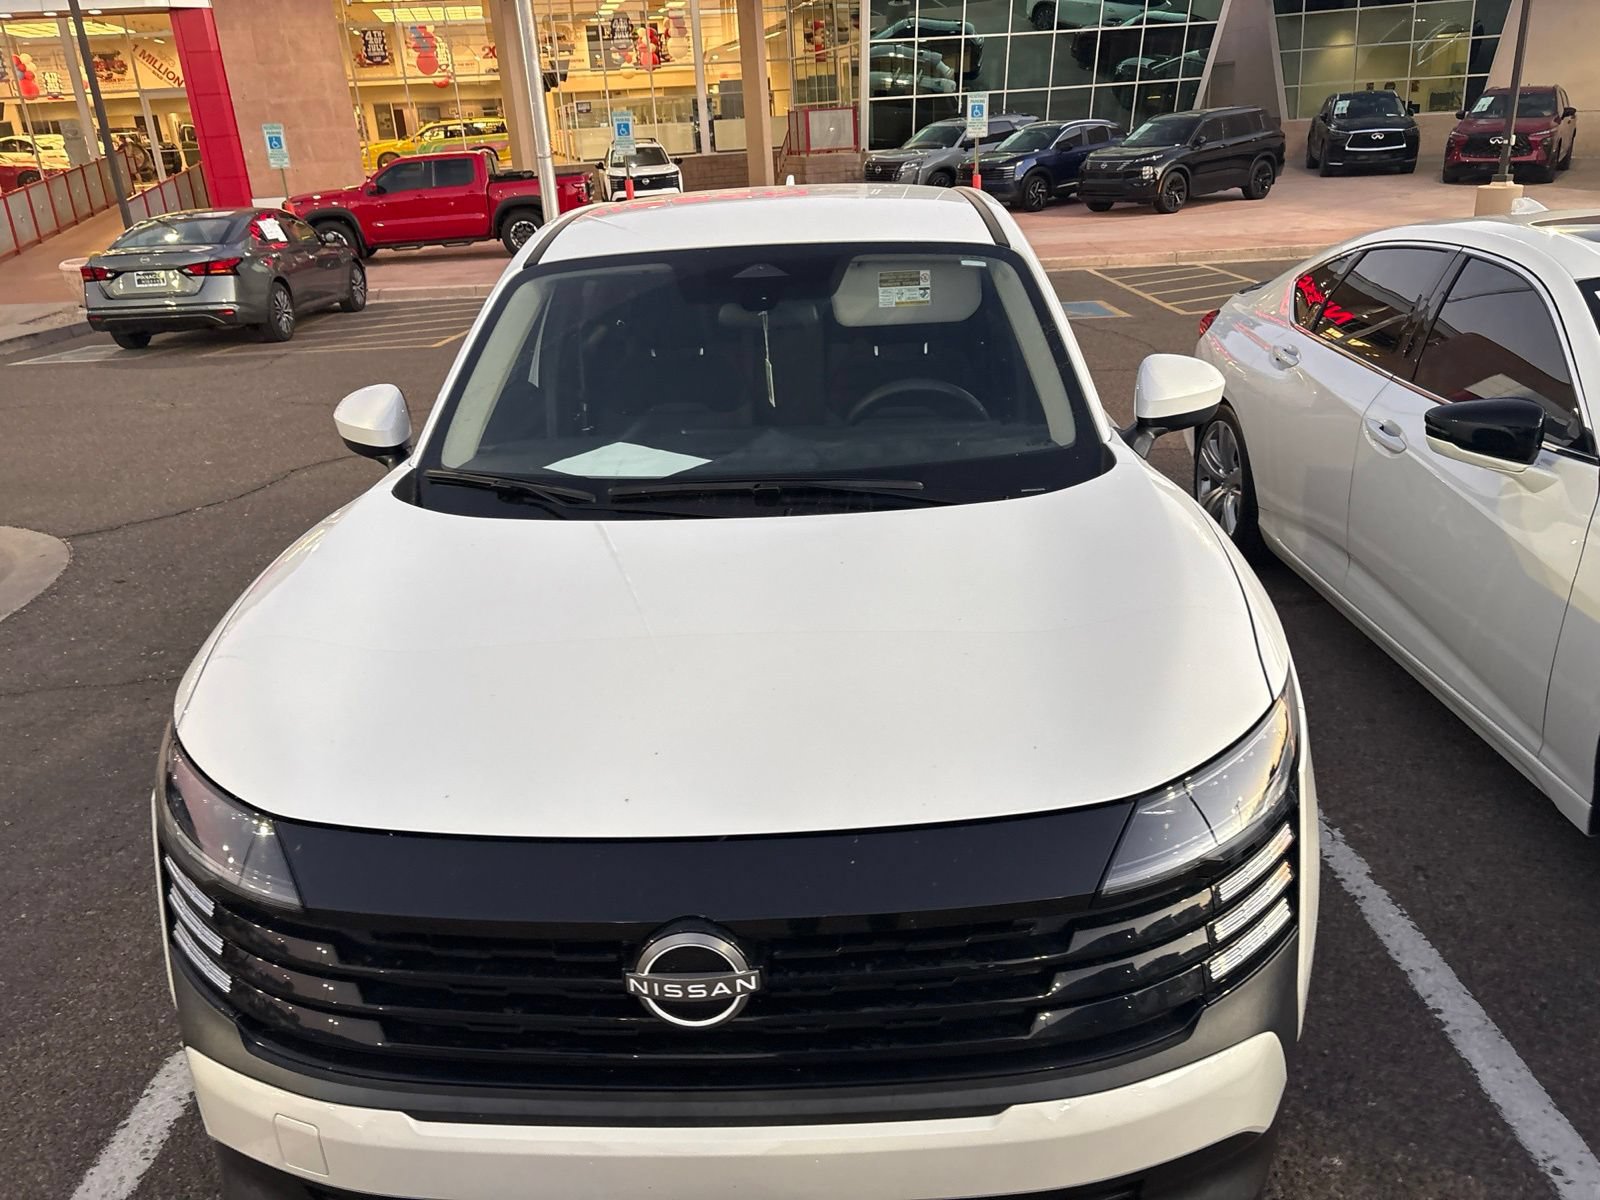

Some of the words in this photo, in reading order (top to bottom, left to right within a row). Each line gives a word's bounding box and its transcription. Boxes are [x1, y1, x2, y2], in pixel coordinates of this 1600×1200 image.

[365, 31, 382, 43] 4TH
[614, 31, 629, 39] JULY
[367, 44, 384, 52] JULY
[132, 44, 139, 52] 1
[138, 49, 184, 88] MILLION
[628, 974, 759, 999] NISSAN
